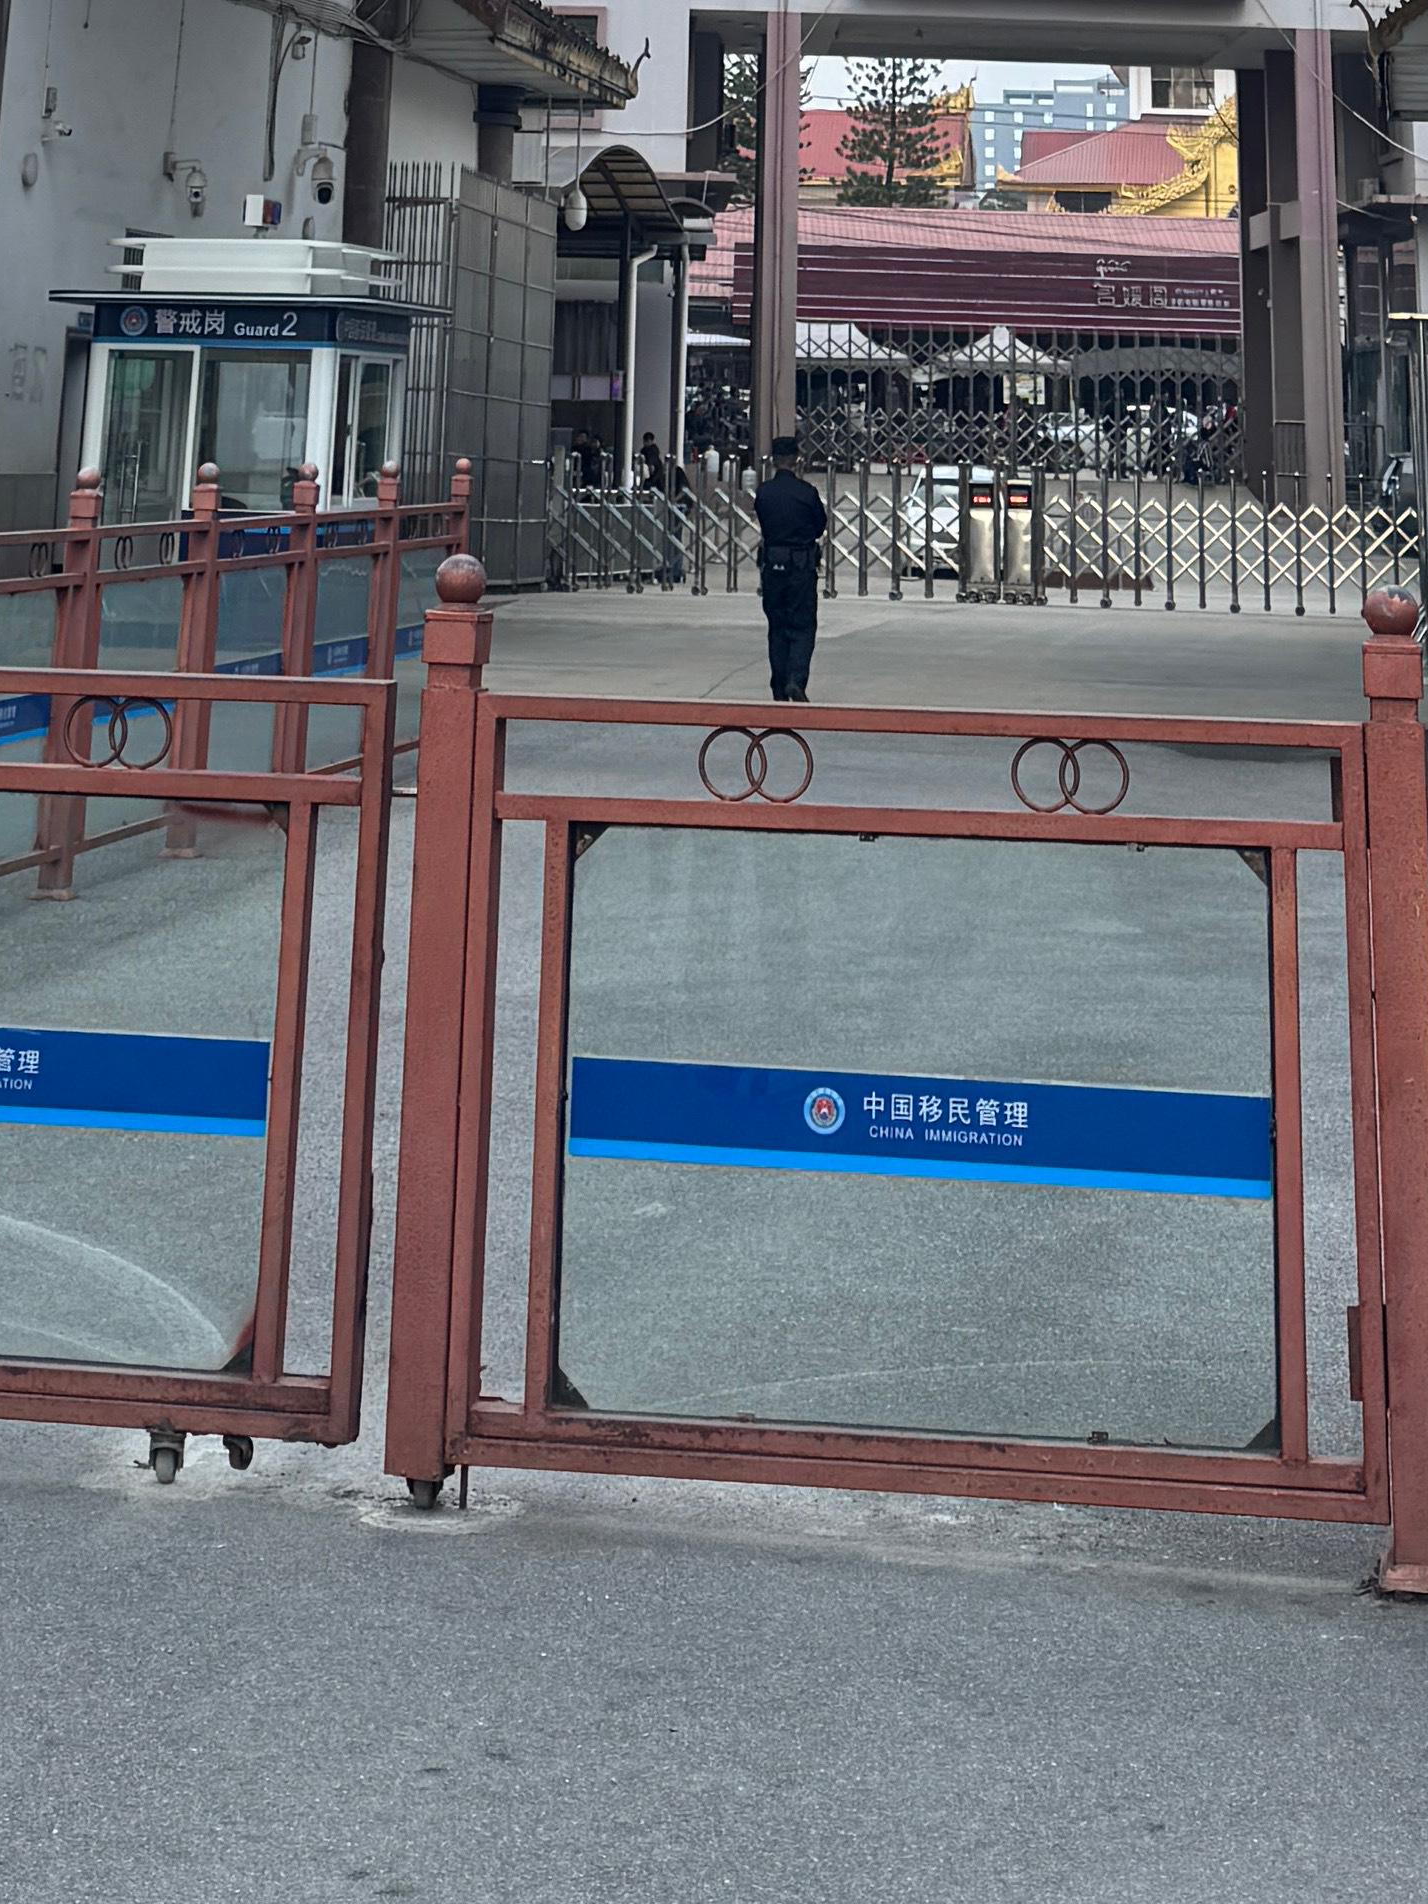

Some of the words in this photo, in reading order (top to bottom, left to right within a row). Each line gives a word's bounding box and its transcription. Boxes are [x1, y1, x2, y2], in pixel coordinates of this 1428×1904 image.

[154, 308, 226, 336] 警戒岗
[234, 322, 280, 337] Guard
[863, 1091, 1029, 1128] 中国移民管理
[869, 1125, 914, 1141] CHINA
[924, 1128, 1023, 1146] IMMIGRATION
